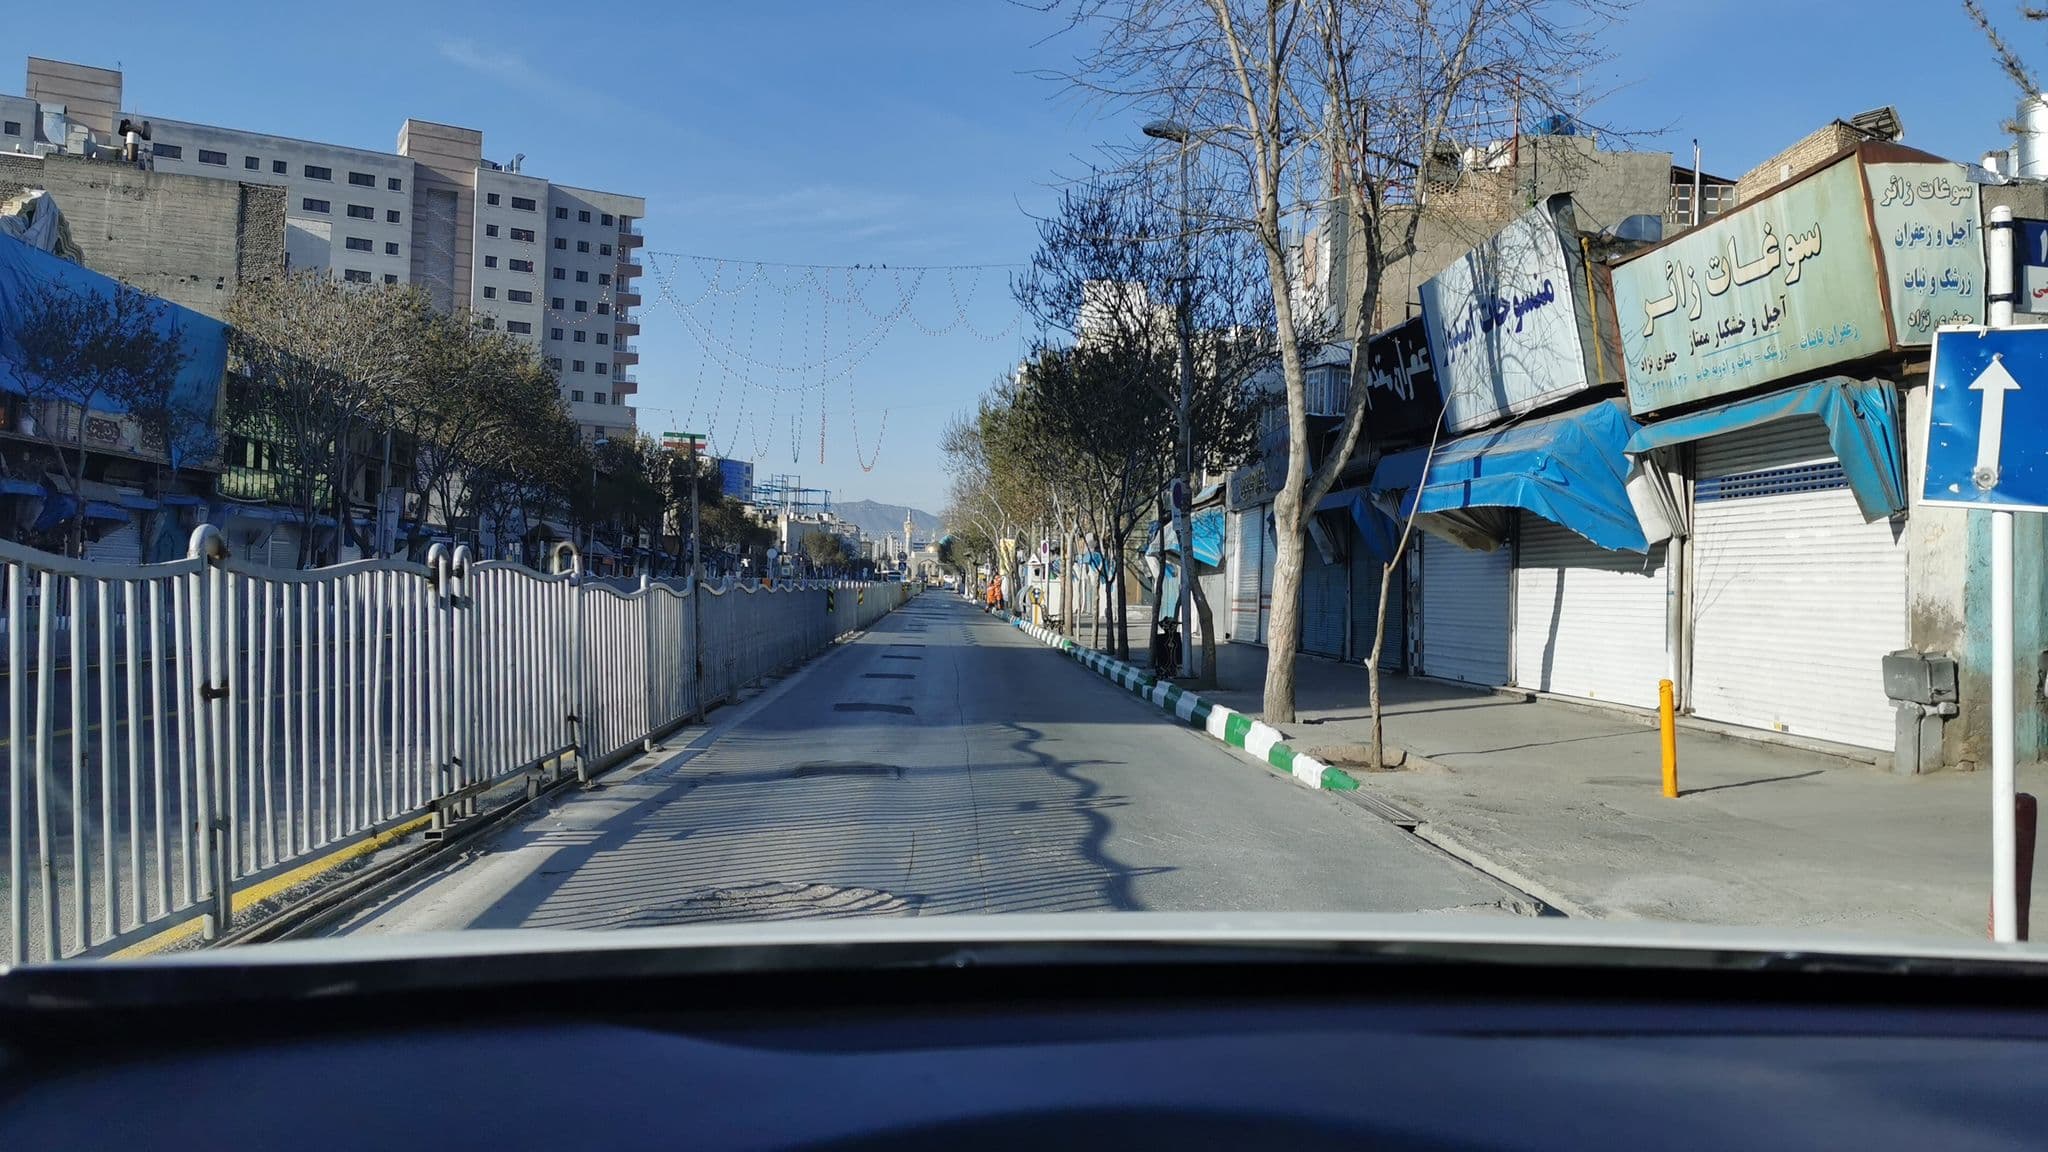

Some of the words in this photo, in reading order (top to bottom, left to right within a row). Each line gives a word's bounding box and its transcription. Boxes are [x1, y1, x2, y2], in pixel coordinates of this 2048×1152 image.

[1880, 174, 1915, 206] زائر
[1917, 176, 1973, 206] سوغات
[1894, 221, 1932, 247] زعفران
[1936, 228, 1942, 247] و
[1945, 220, 1973, 246] آجیل
[1704, 222, 1822, 296] سوغات
[1904, 267, 1926, 294] نبات
[1929, 279, 1936, 295] و
[1939, 267, 1972, 295] زرشک
[1642, 260, 1703, 338] زائر
[1761, 294, 1787, 332] آجیل
[1907, 309, 1931, 333] نژاد
[1715, 312, 1746, 348] خشکبار
[1751, 317, 1758, 337] و
[1827, 320, 1860, 345] زعفران
[1689, 328, 1710, 356] ممتاز
[1655, 350, 1678, 371] جعفری
